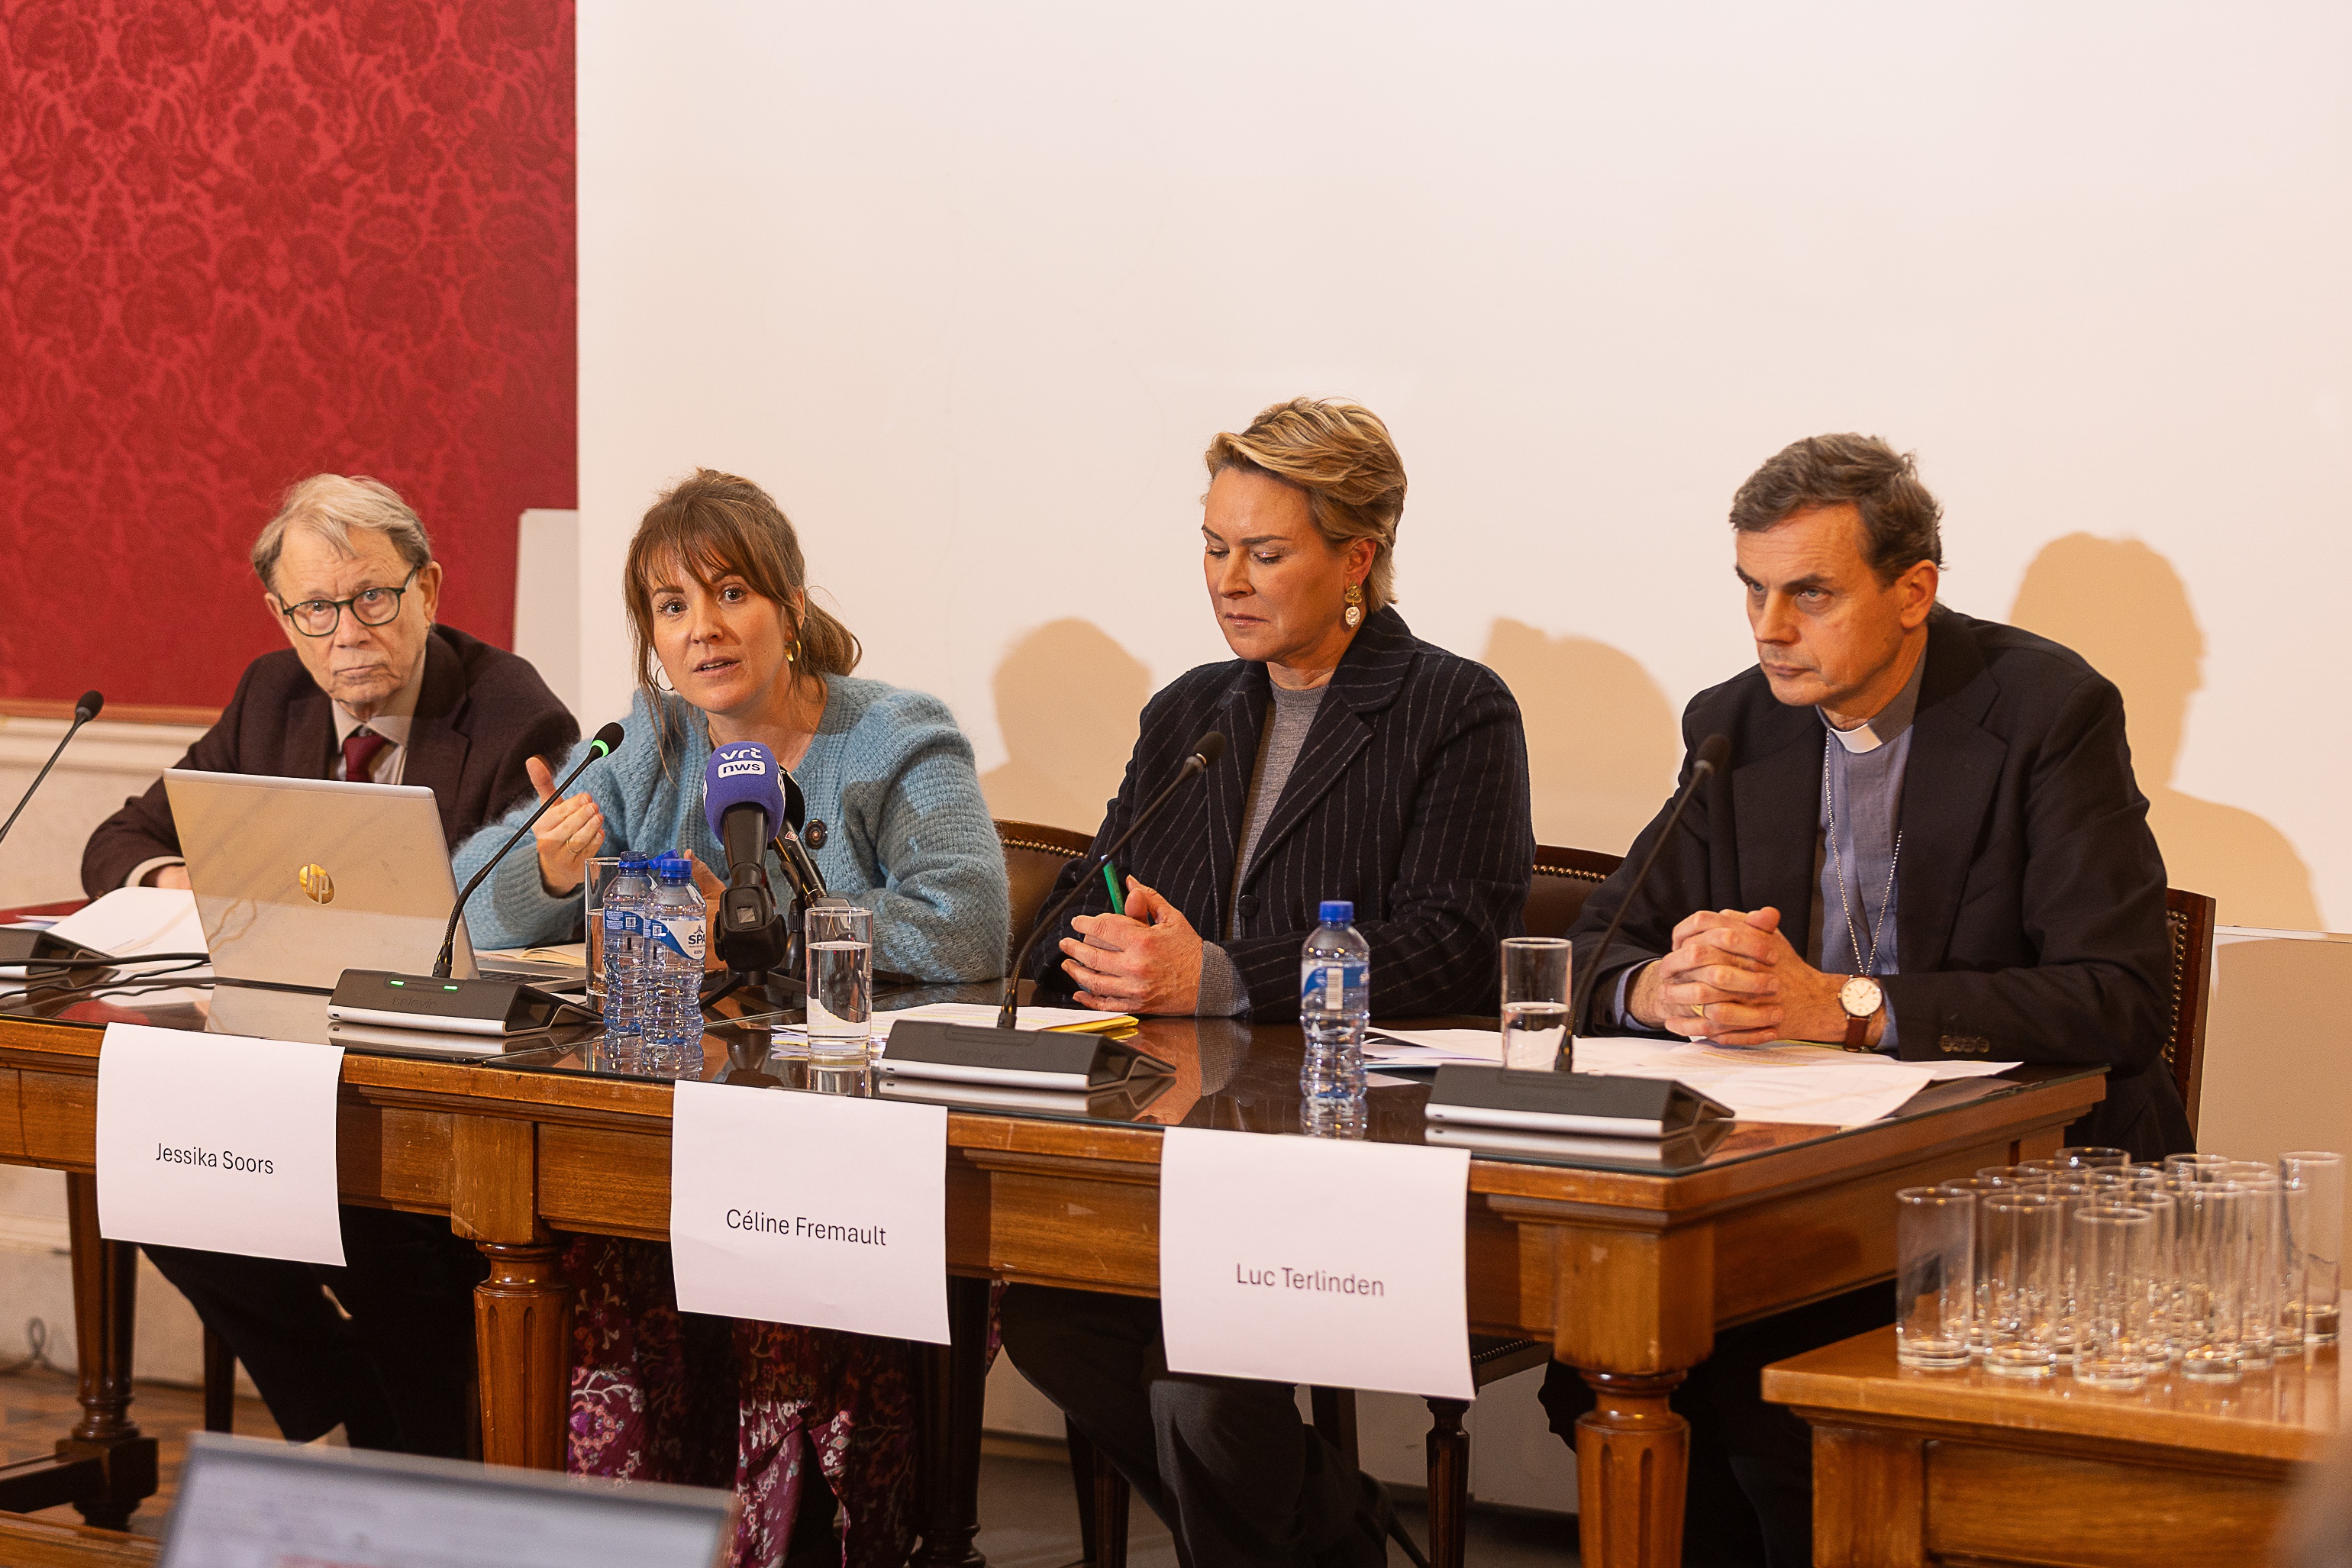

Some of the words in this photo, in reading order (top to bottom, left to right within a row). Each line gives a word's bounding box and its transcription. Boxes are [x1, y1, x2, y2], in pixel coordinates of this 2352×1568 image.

[720, 747, 763, 760] vrt
[723, 763, 760, 773] nws
[306, 863, 329, 904] hp
[156, 1143, 217, 1167] Jessika
[223, 1150, 274, 1174] Soors
[727, 1209, 789, 1234] Céline
[796, 1217, 886, 1246] Fremault
[1237, 1263, 1276, 1286] Luc
[1281, 1266, 1384, 1296] Terlinden
